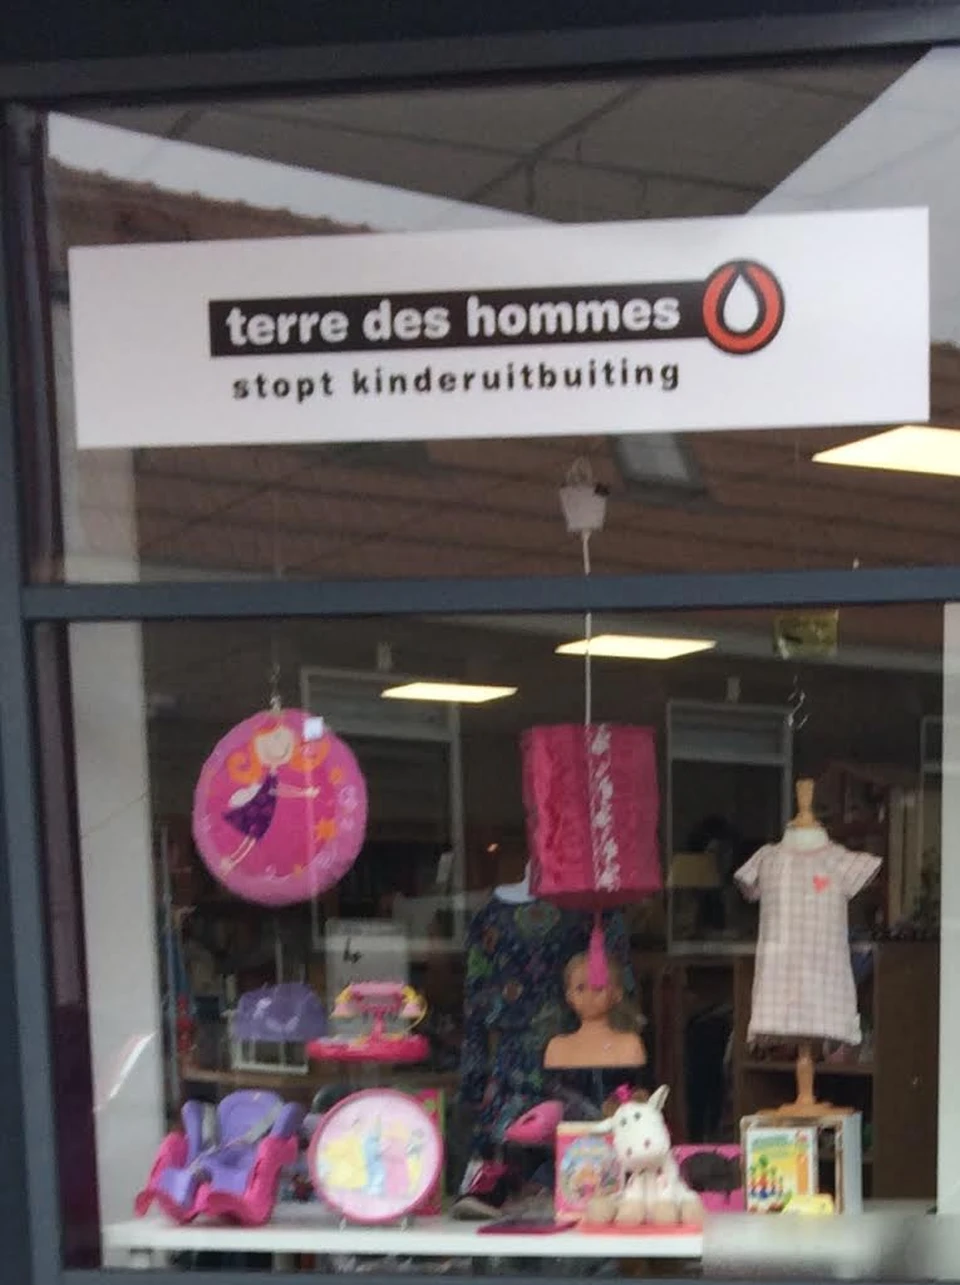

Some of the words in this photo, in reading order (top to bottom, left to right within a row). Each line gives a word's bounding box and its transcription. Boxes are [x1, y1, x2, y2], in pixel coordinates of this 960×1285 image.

[226, 306, 349, 346] terre
[362, 299, 450, 341] des
[466, 295, 681, 337] hommes
[232, 371, 334, 404] stopt
[351, 359, 680, 394] kinderuitbuiting
